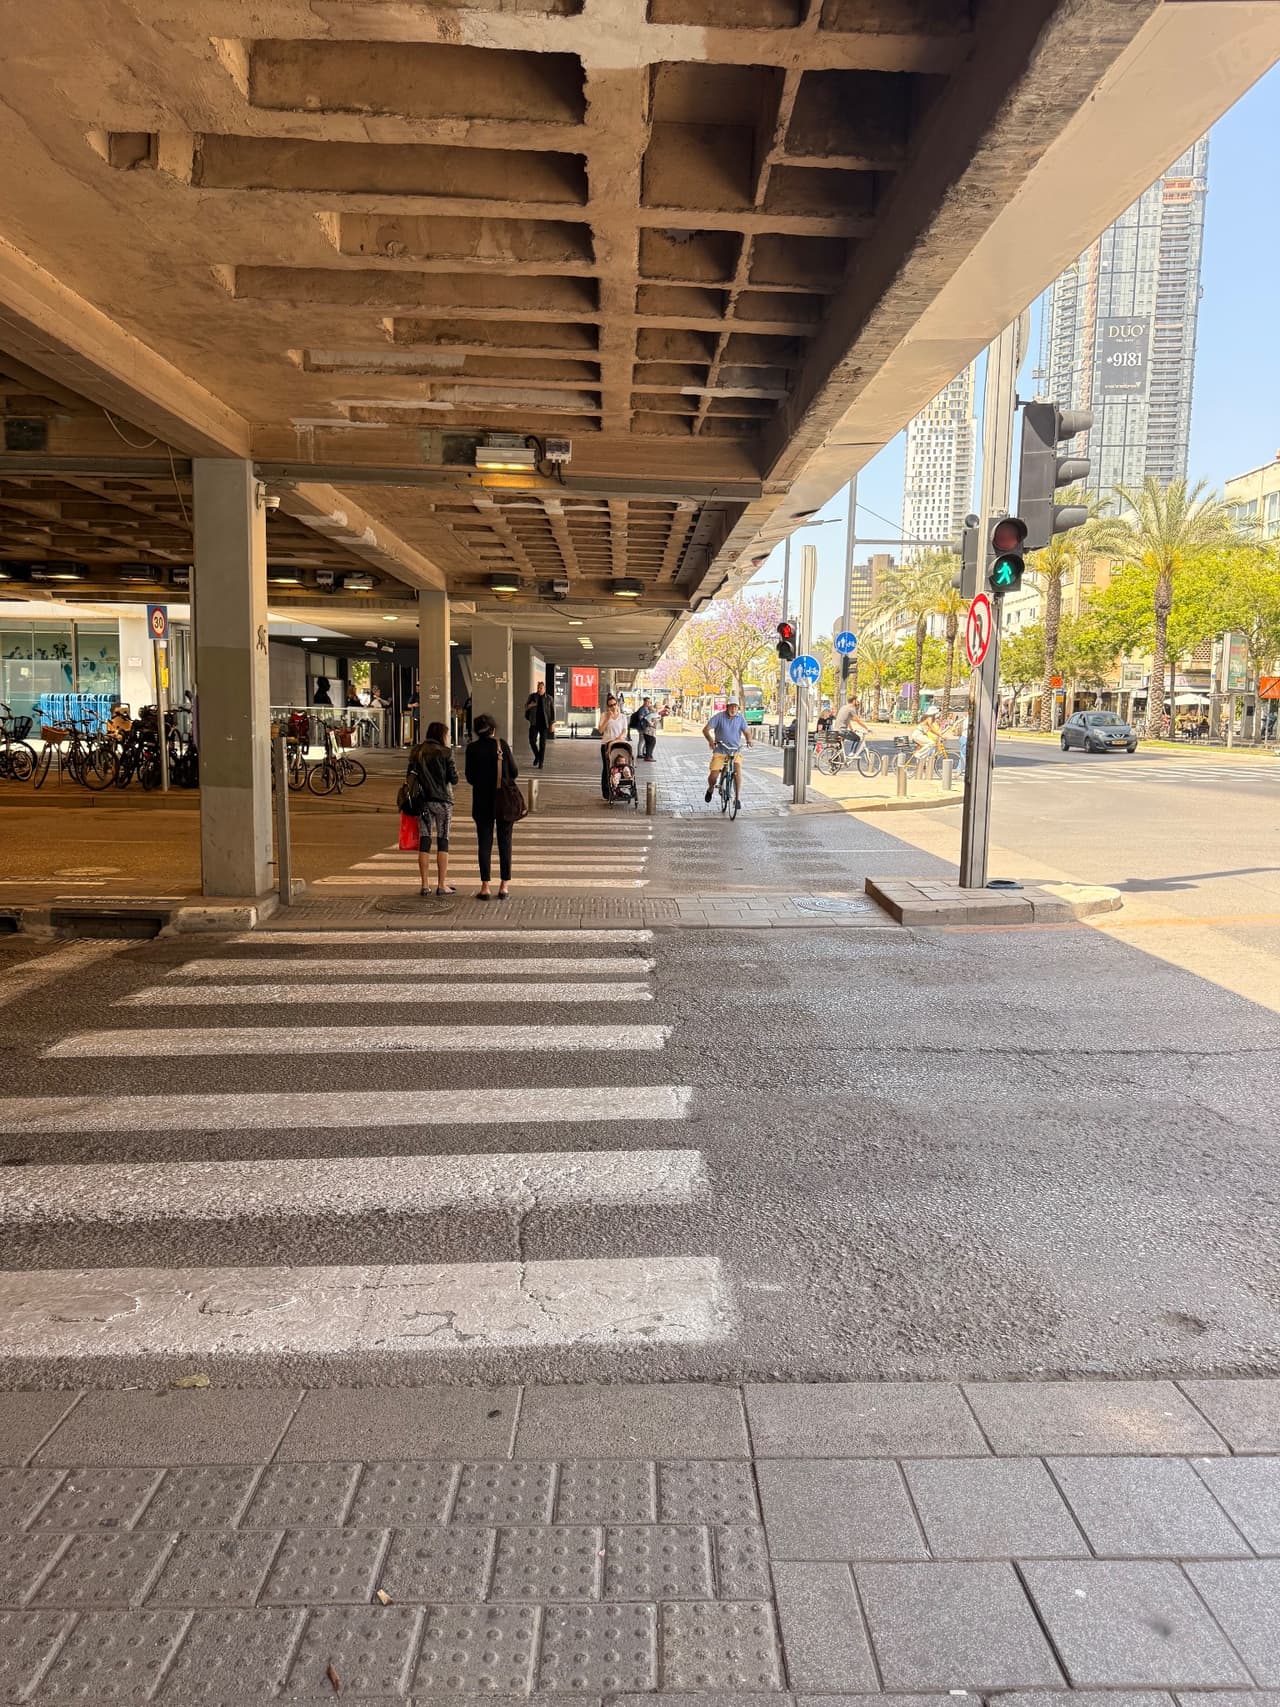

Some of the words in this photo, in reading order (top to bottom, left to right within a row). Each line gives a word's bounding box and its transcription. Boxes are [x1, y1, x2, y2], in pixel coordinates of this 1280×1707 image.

[1108, 325, 1143, 338] DUO
[154, 616, 163, 629] 30
[573, 674, 594, 687] TLV
